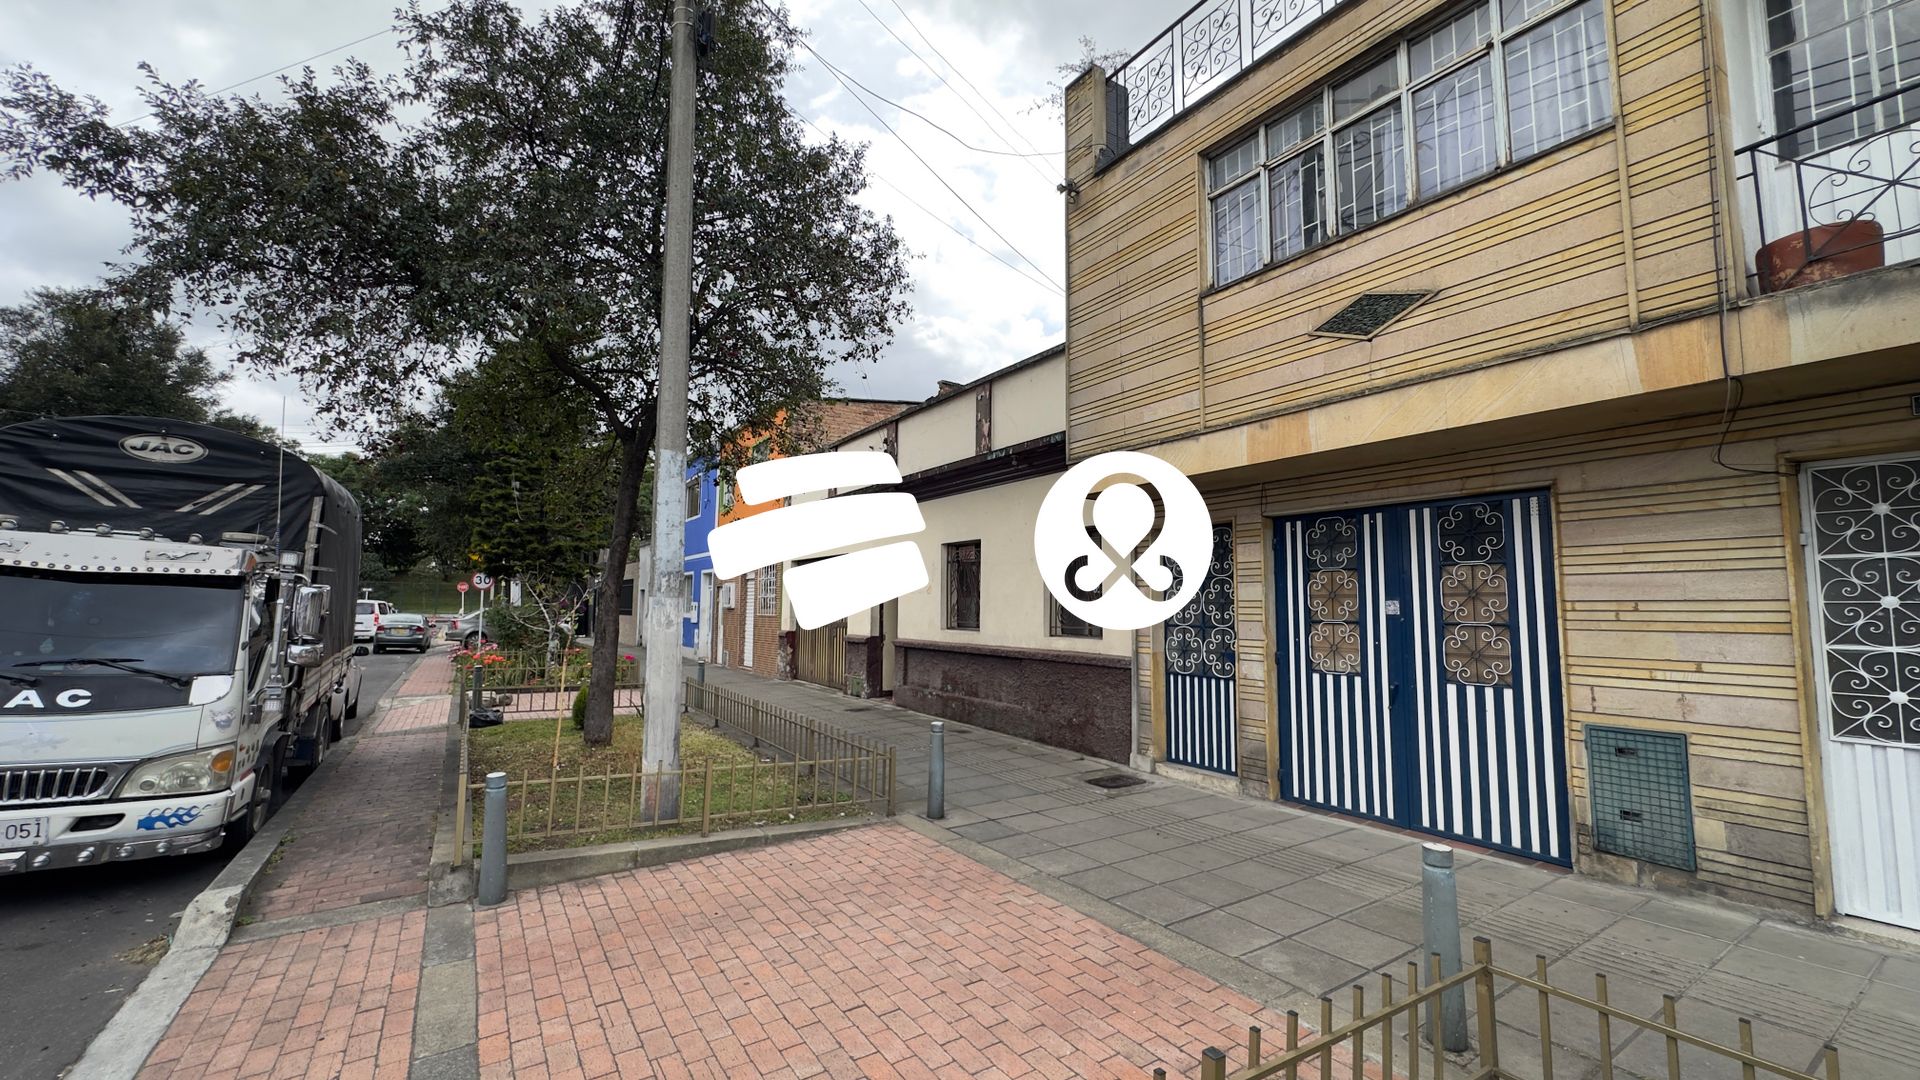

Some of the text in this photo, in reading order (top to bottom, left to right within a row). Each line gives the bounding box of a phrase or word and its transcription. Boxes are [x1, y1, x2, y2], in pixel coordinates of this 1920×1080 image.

[129, 440, 195, 455] JAC
[475, 575, 491, 585] 30
[5, 822, 41, 840] 051
